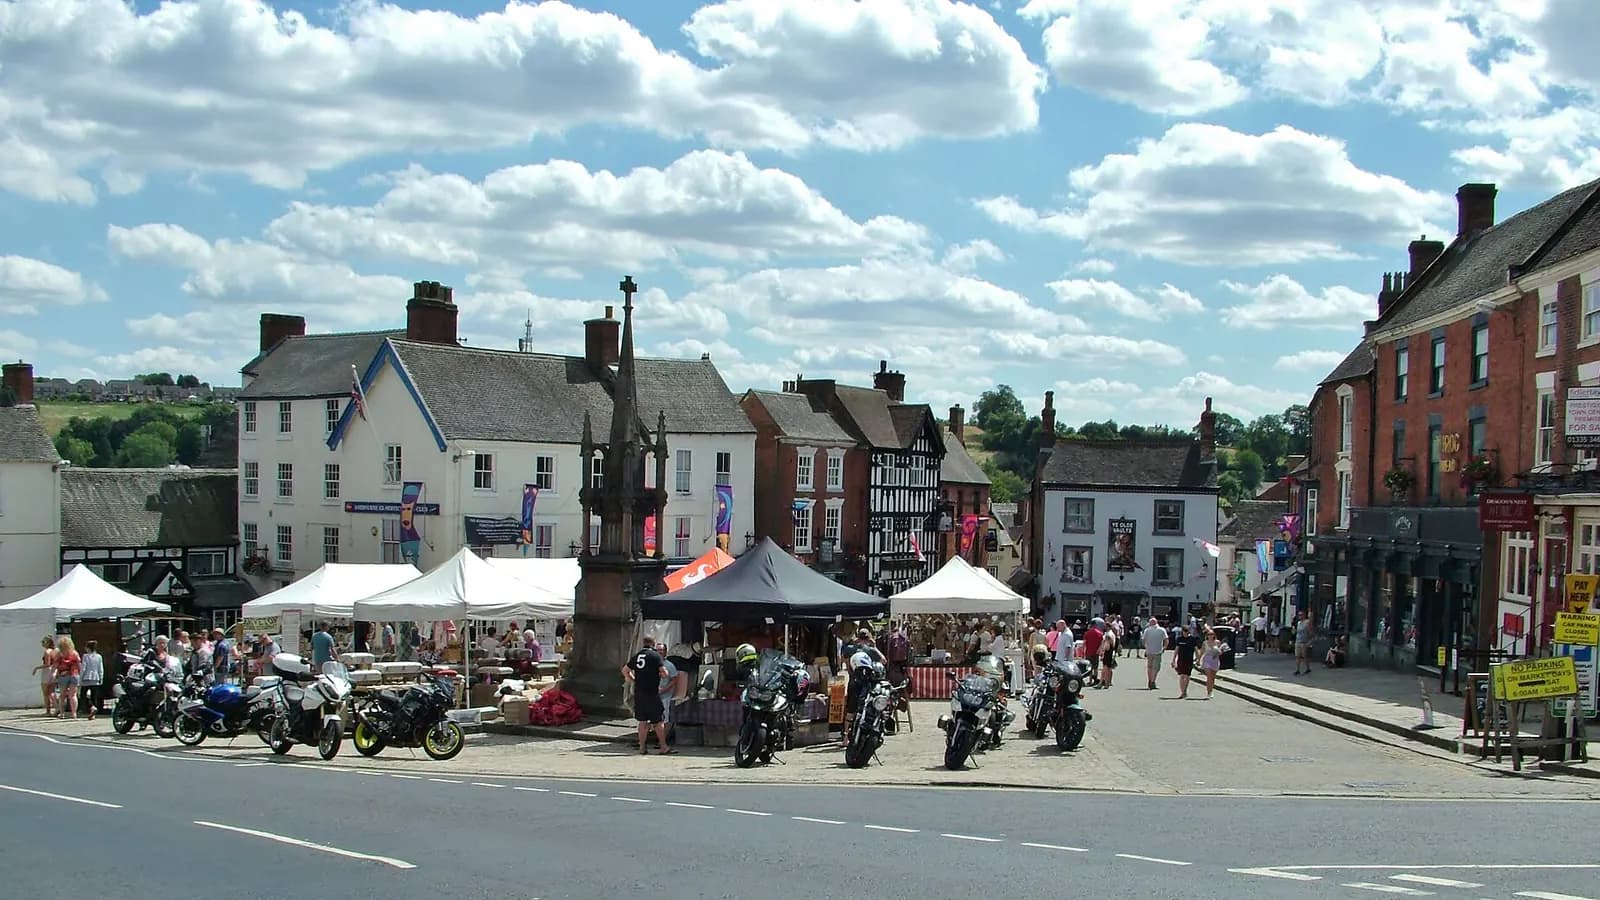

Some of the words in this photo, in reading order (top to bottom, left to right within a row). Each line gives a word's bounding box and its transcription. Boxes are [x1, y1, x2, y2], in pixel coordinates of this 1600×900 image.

[1568, 424, 1586, 432] FOR
[1574, 580, 1588, 590] PAY
[1571, 592, 1591, 602] HERE
[1561, 613, 1597, 622] WARNING
[636, 654, 646, 668] 5
[1511, 663, 1524, 672] NO
[1526, 660, 1565, 671] PARKING
